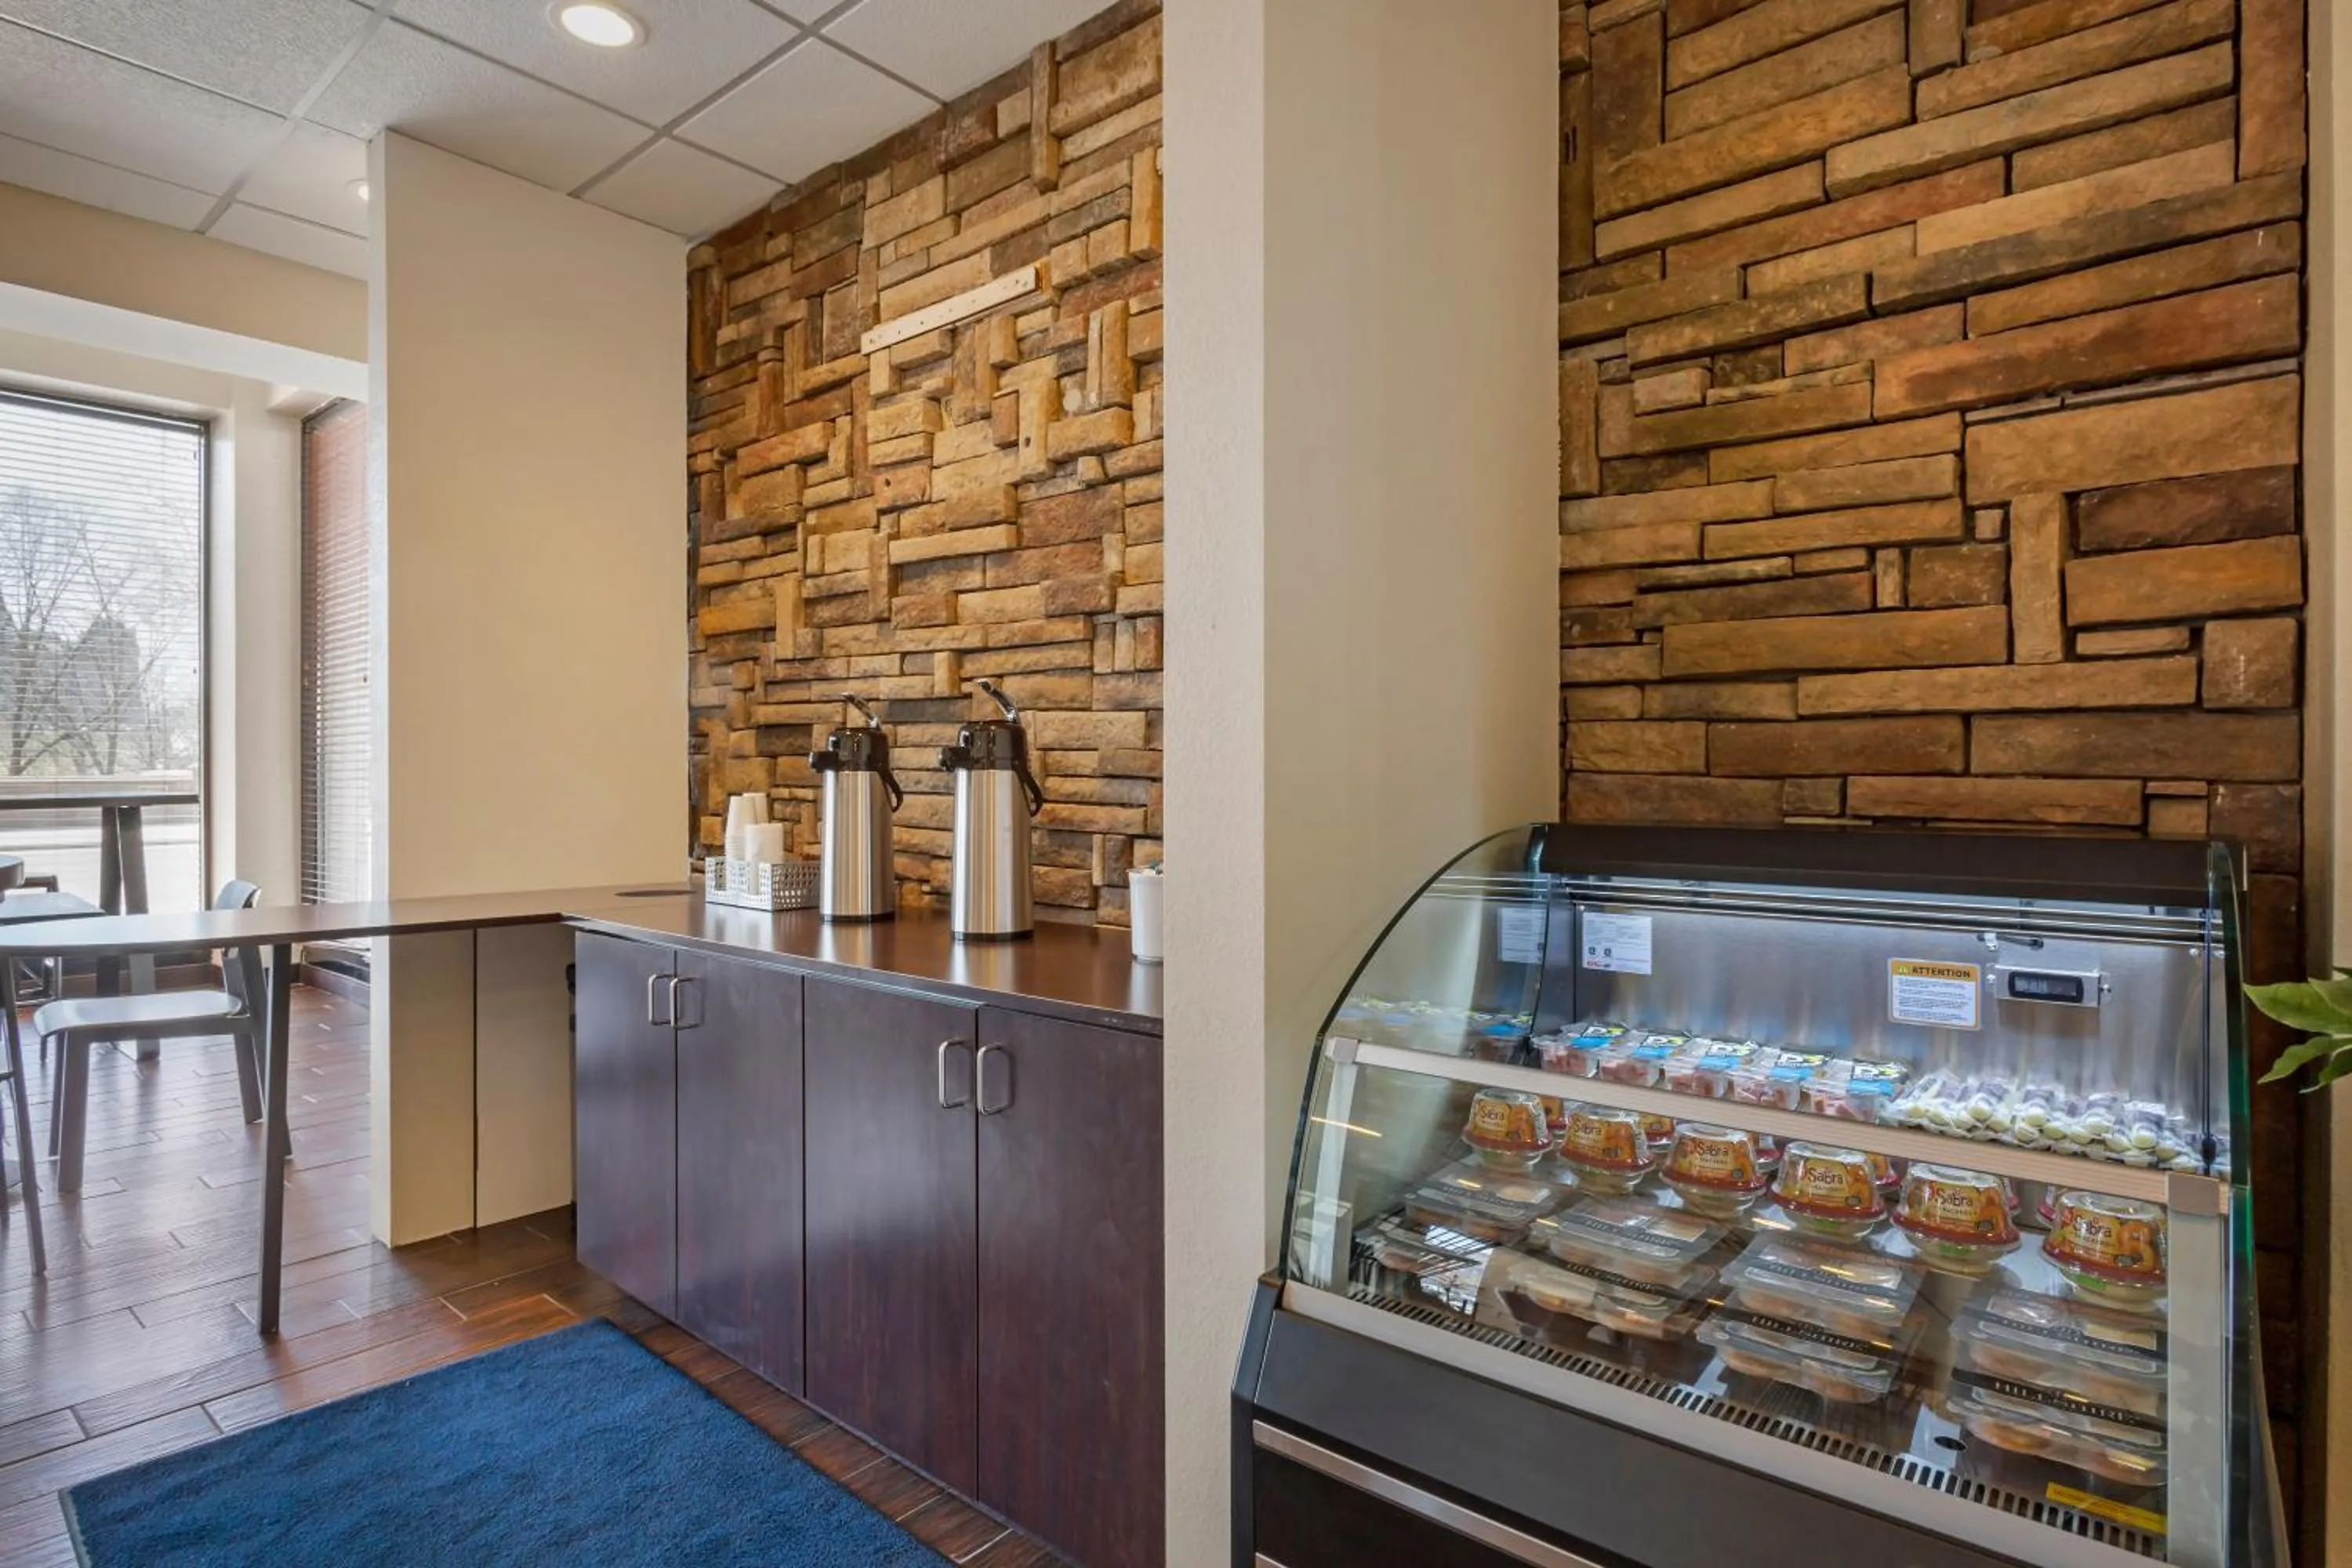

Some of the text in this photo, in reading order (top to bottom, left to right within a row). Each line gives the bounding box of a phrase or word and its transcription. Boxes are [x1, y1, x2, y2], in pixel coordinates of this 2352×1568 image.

[1911, 967, 1970, 978] ATTENTION
[1697, 1141, 1729, 1156] Sabra
[1806, 1167, 1843, 1185] Sabra
[1936, 1188, 1973, 1207] Sabra
